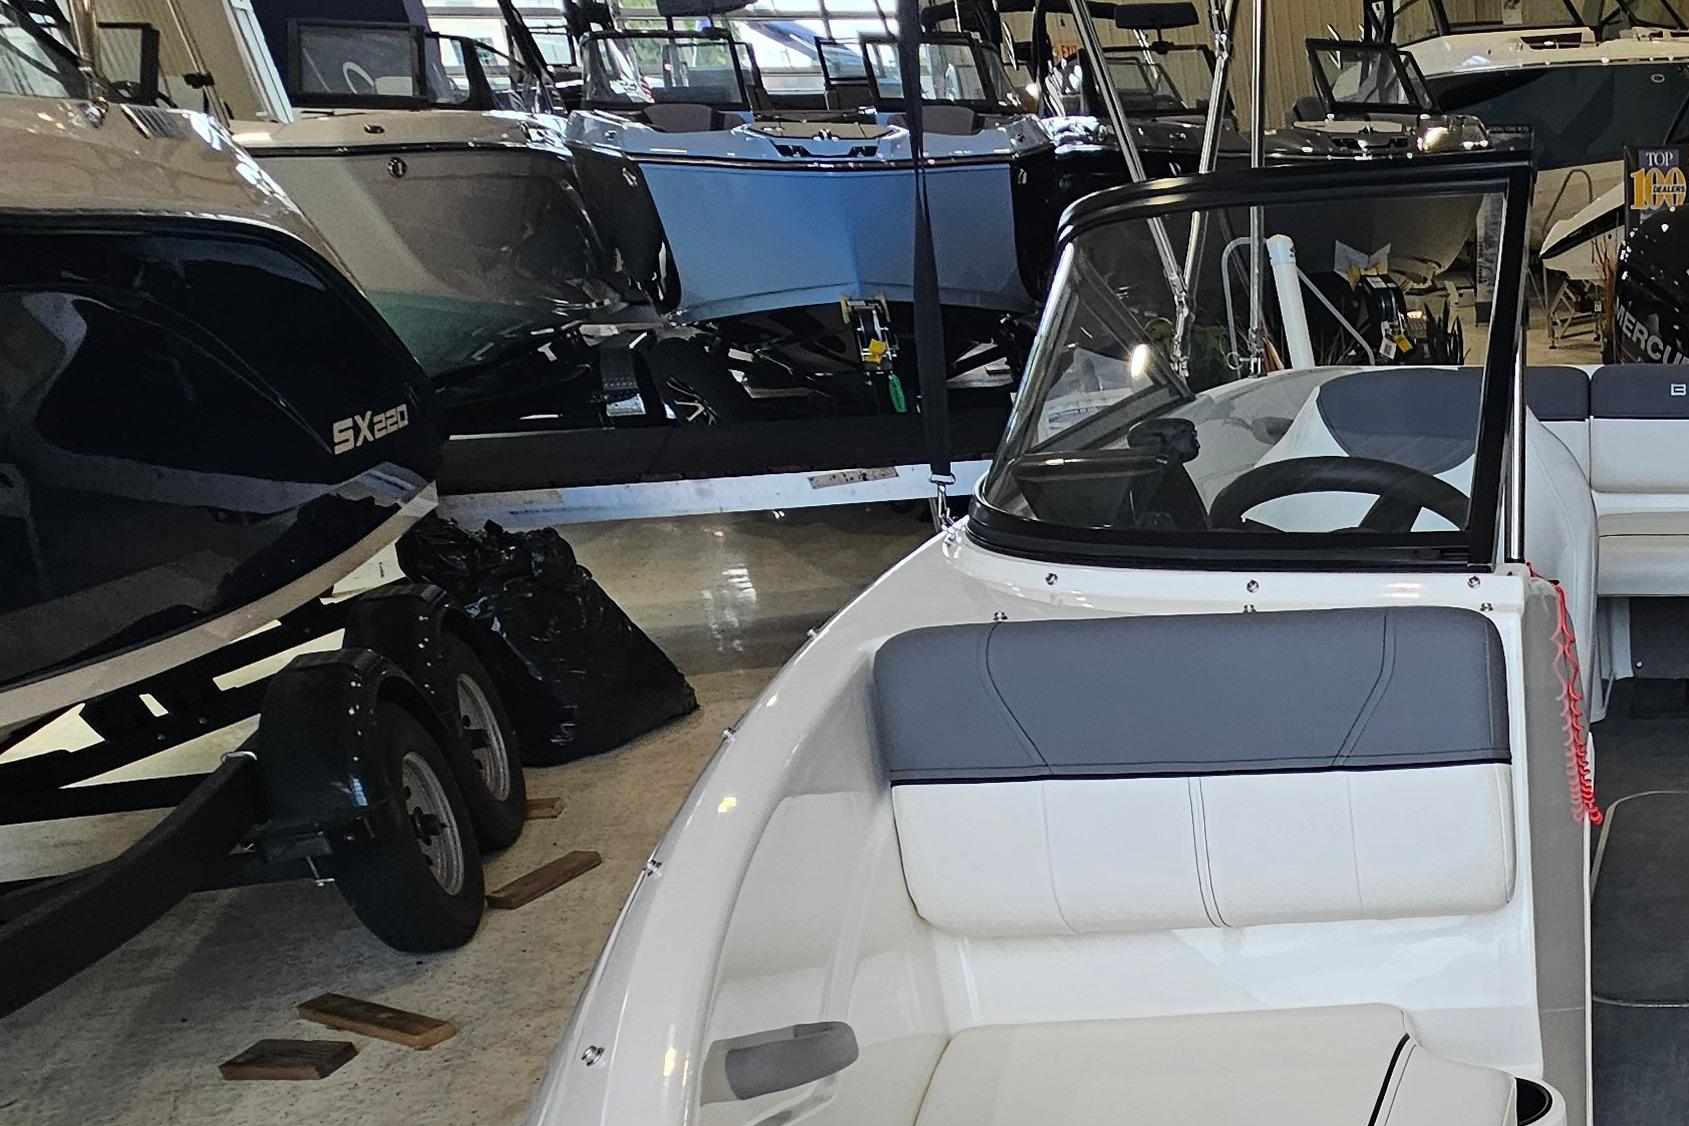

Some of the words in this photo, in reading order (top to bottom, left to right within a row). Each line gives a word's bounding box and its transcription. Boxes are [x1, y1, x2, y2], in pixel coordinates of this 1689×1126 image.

[1646, 151, 1674, 167] TOP
[1630, 167, 1687, 209] 100
[1653, 185, 1686, 193] DEALERS
[332, 403, 409, 455] SX220
